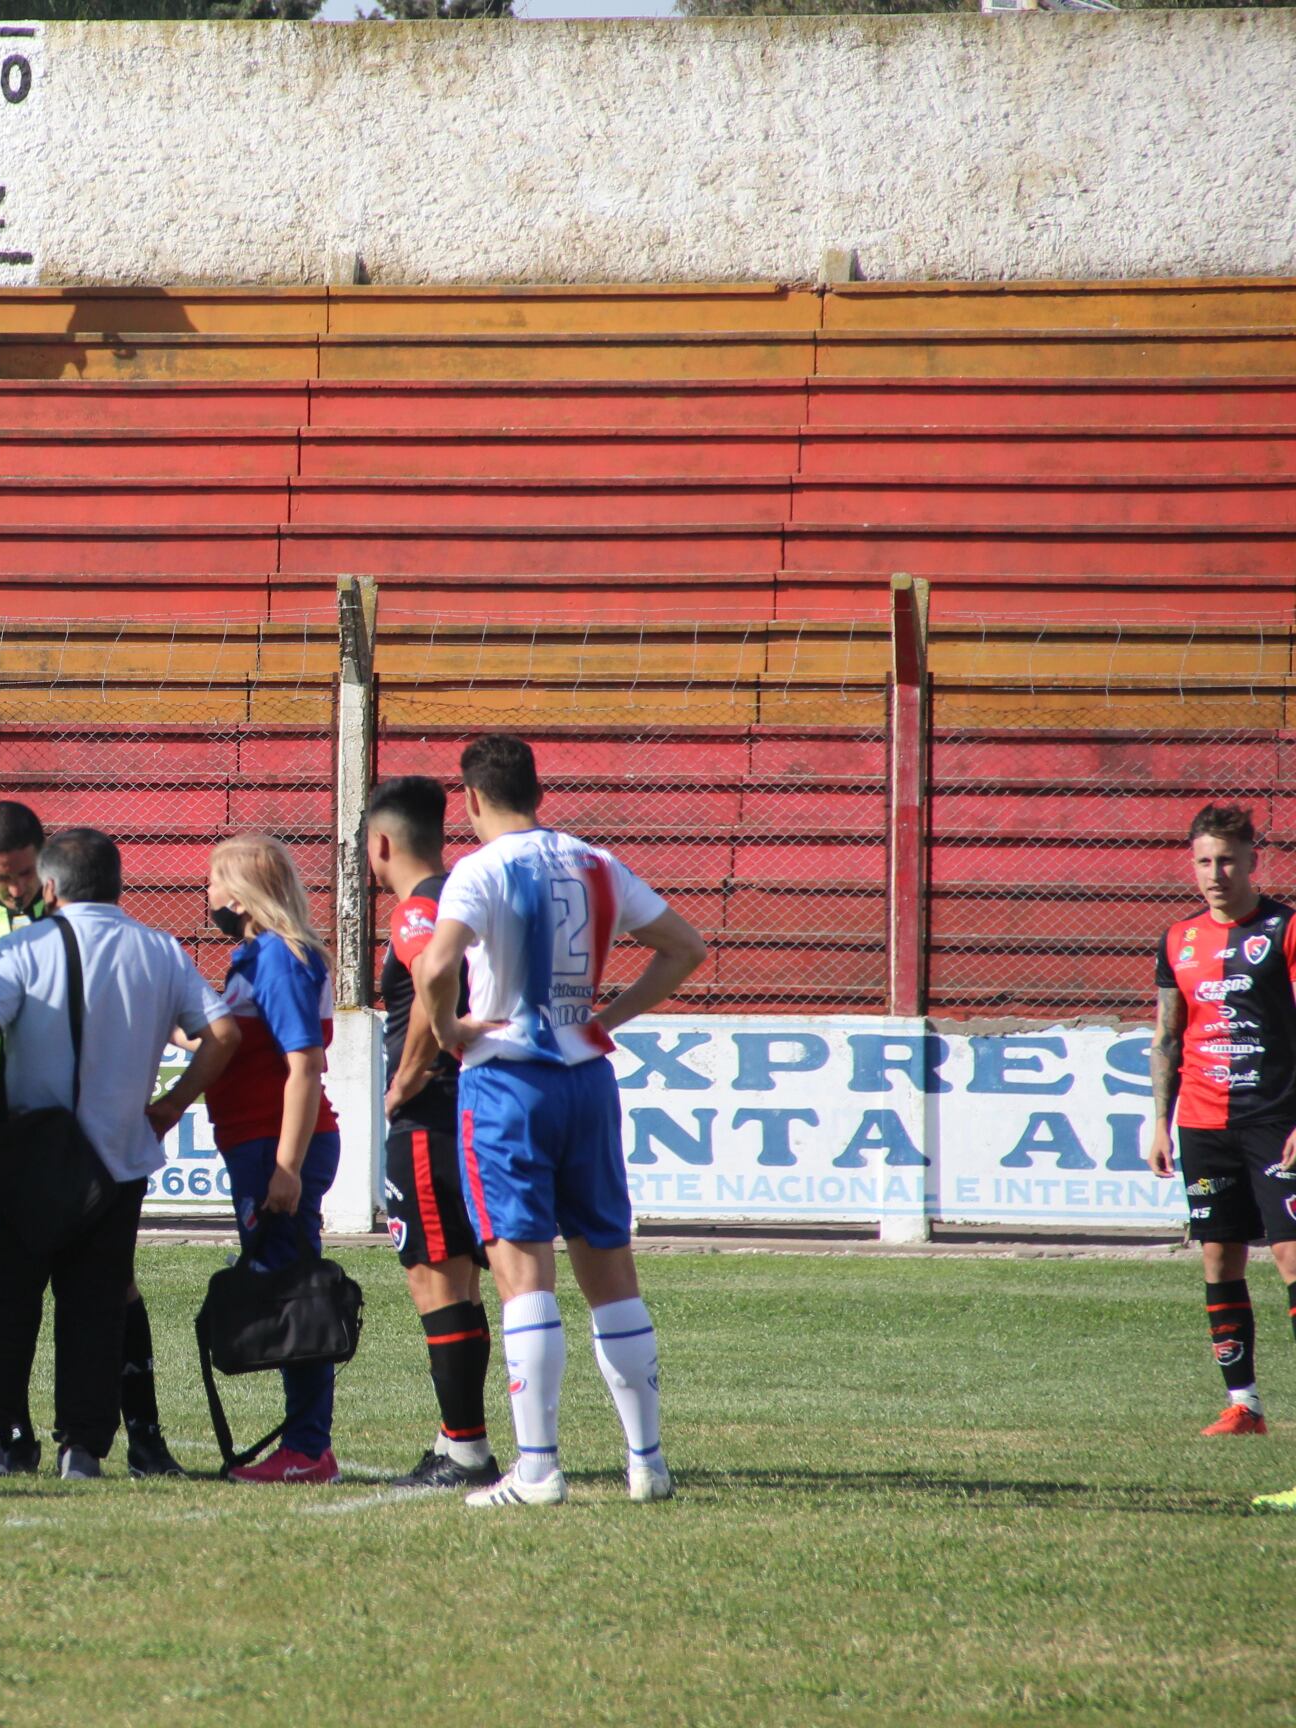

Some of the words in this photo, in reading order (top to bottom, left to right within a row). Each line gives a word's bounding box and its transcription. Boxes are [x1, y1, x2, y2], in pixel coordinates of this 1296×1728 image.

[551, 878, 590, 976] 2
[1199, 978, 1253, 993] PESOS
[627, 1107, 931, 1168] NTA
[716, 1174, 938, 1203] NACIONAL
[956, 1177, 981, 1202] E
[994, 1179, 1187, 1208] INTERNA
